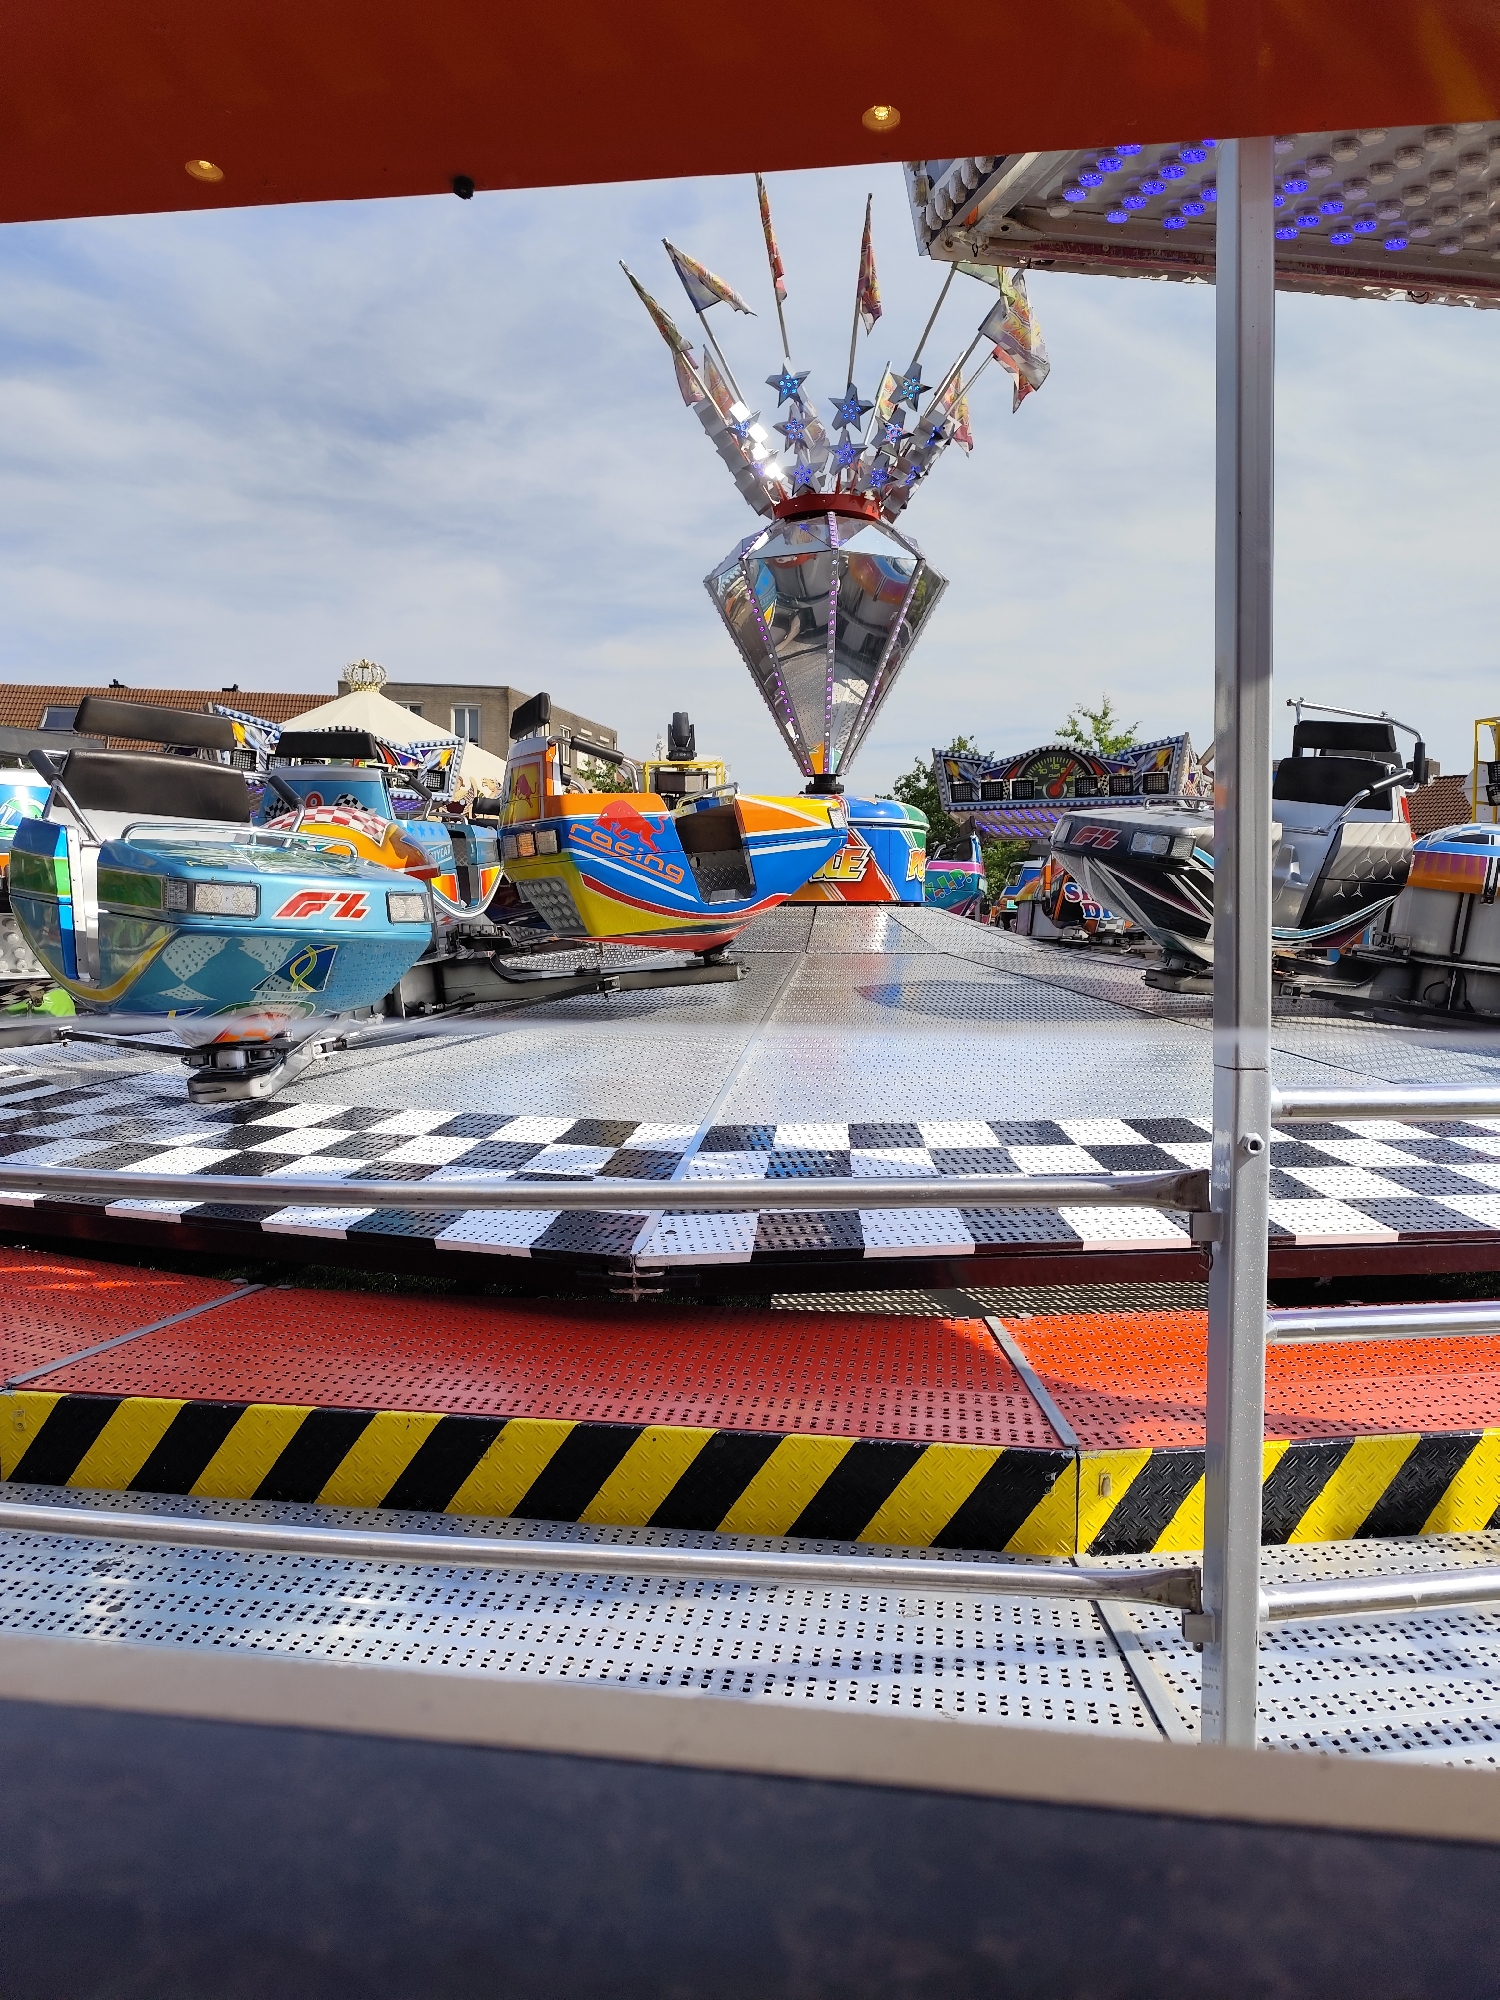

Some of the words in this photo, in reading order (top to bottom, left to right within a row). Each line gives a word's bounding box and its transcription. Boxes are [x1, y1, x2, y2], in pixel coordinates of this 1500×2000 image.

[569, 823, 685, 885] racing
[1069, 825, 1122, 850] F1
[808, 844, 873, 883] CE
[271, 888, 371, 921] F1
